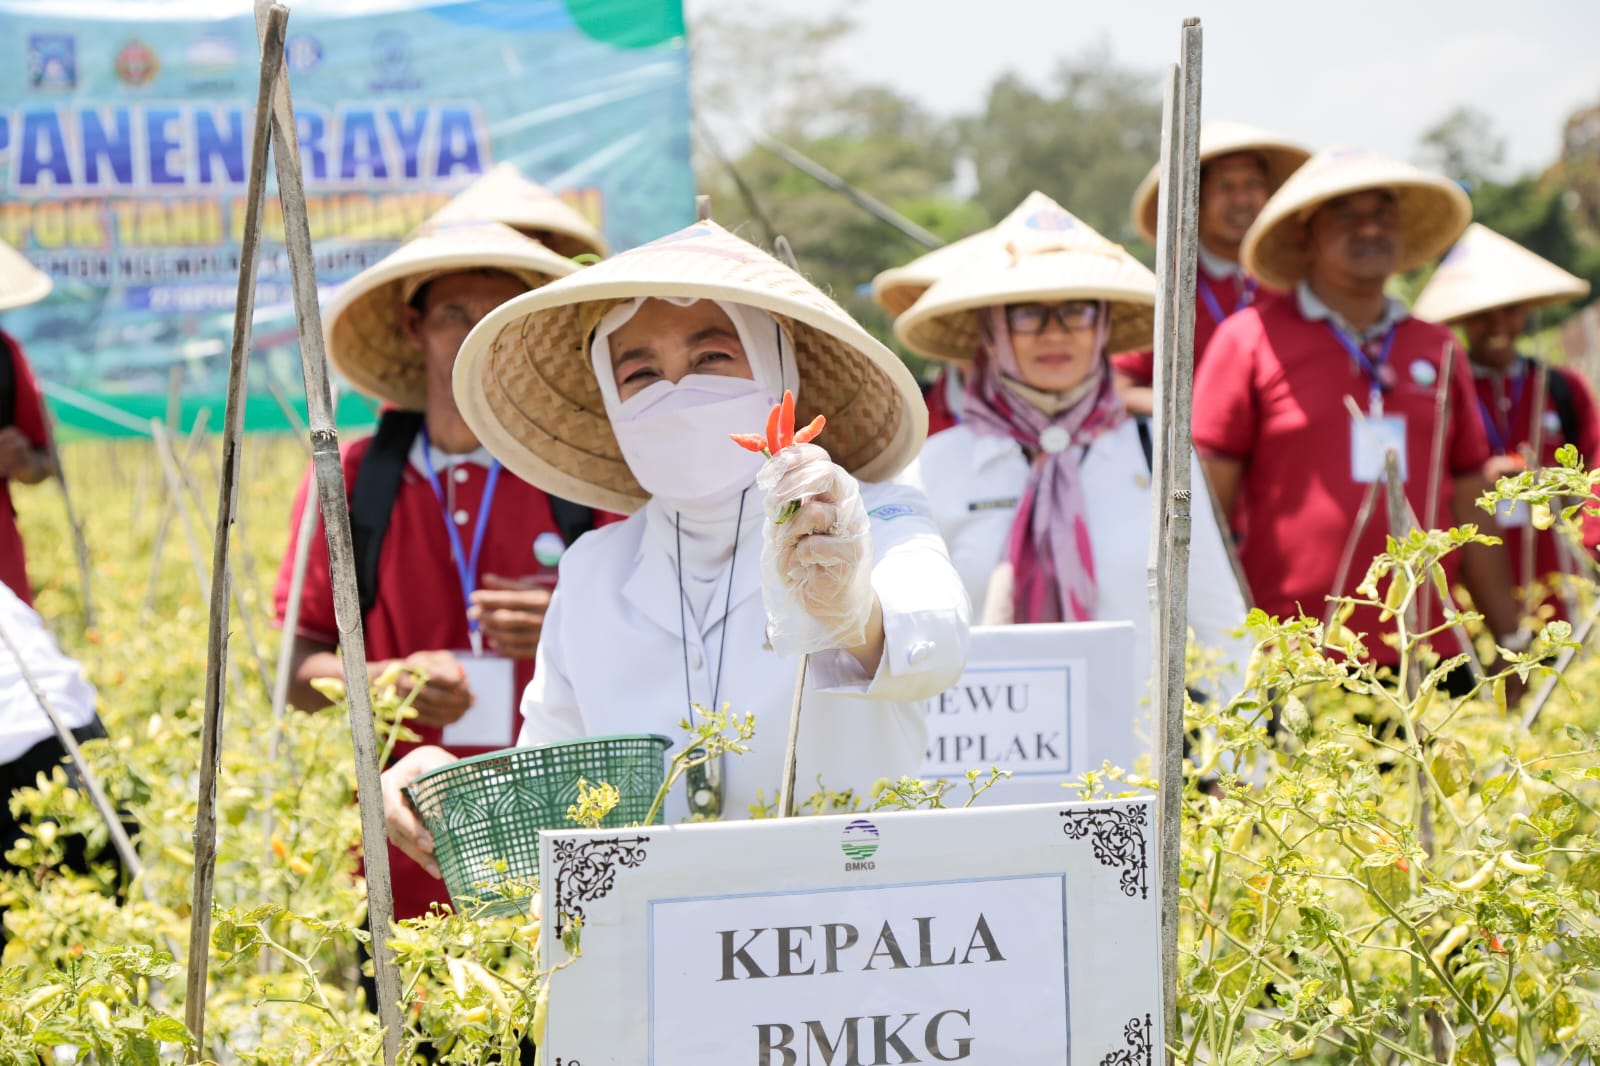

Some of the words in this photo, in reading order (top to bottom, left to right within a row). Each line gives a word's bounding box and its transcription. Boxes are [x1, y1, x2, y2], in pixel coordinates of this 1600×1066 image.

[0, 107, 245, 185] ANEN
[294, 107, 484, 180] RAYA
[845, 861, 876, 872] BMKG
[715, 912, 1007, 982] KEPALA
[752, 1008, 976, 1066] BMKG
